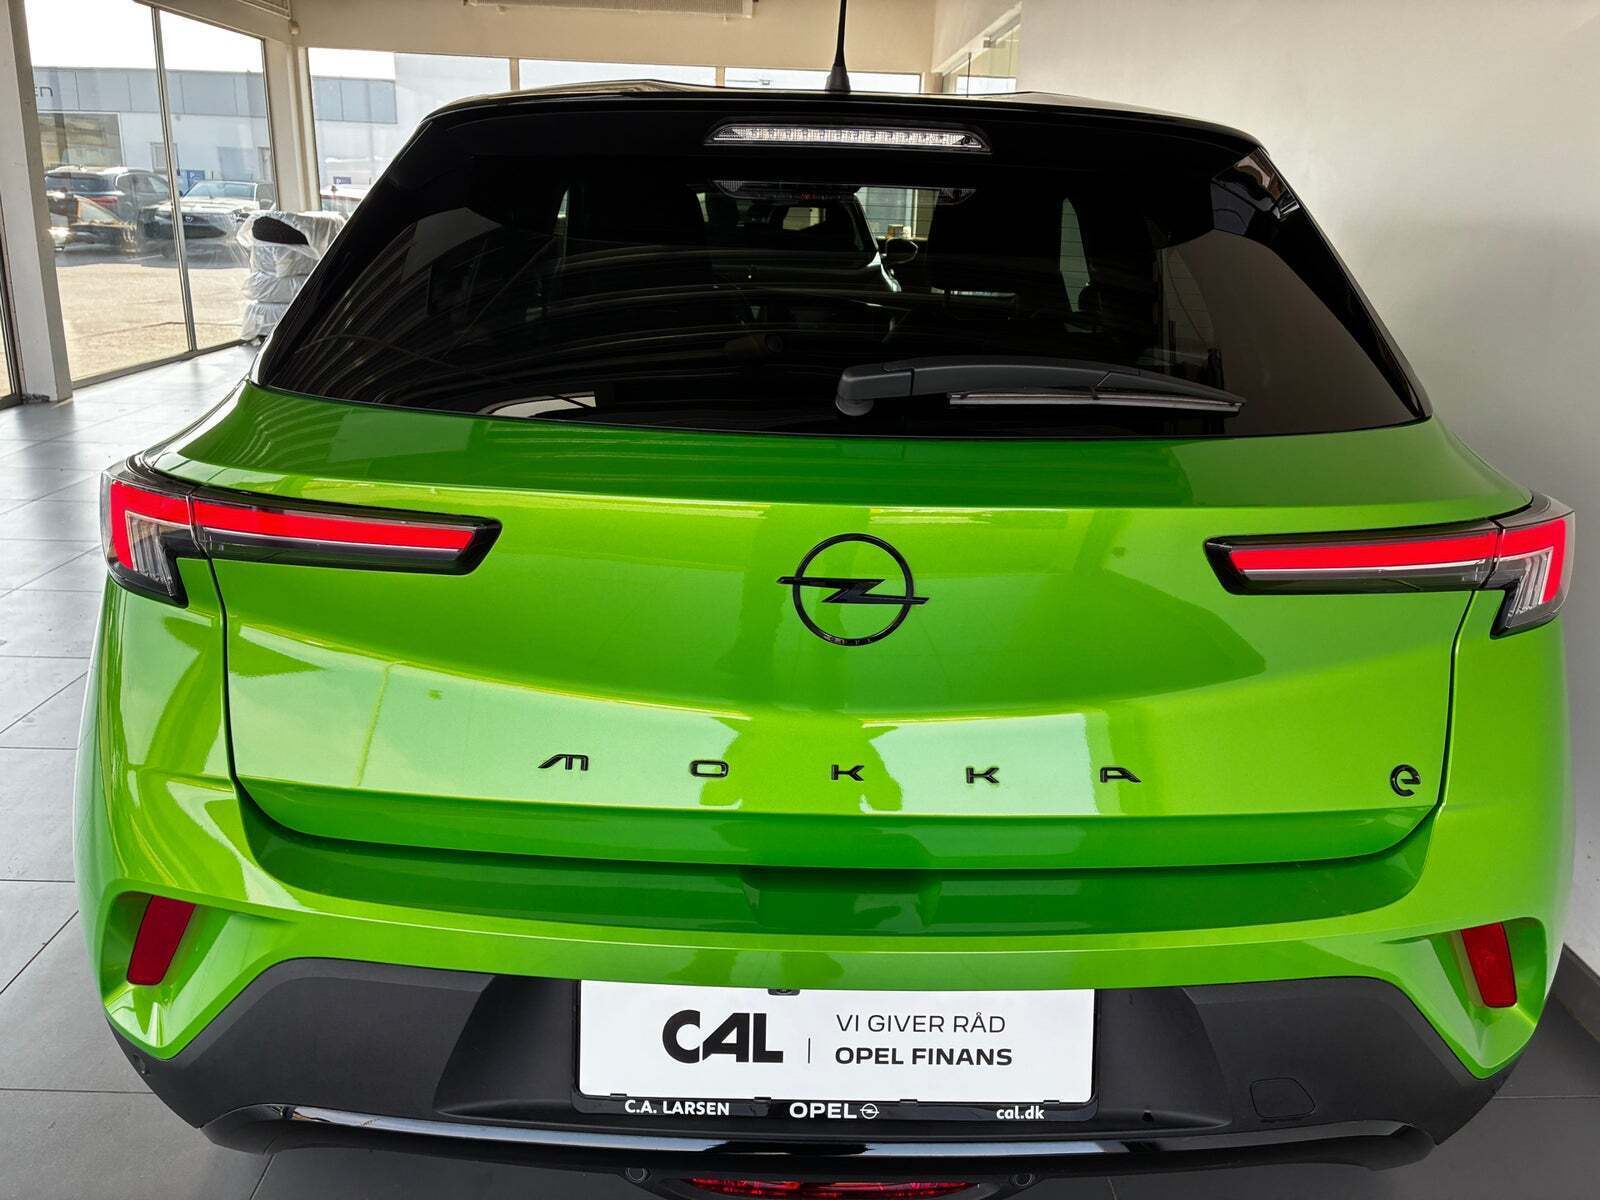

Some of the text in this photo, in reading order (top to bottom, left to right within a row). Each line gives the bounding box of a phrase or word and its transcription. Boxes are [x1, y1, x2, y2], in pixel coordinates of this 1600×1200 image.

[537, 752, 1142, 785] MOKKA
[1389, 763, 1422, 797] e
[835, 1011, 1006, 1034] VI GIVER RÅD
[662, 1009, 784, 1064] CAL
[835, 1046, 1013, 1067] OPEL FINANS
[624, 1100, 730, 1117] C.A. LARSEN
[789, 1101, 858, 1120] OPEL
[996, 1105, 1045, 1121] cal.dk
